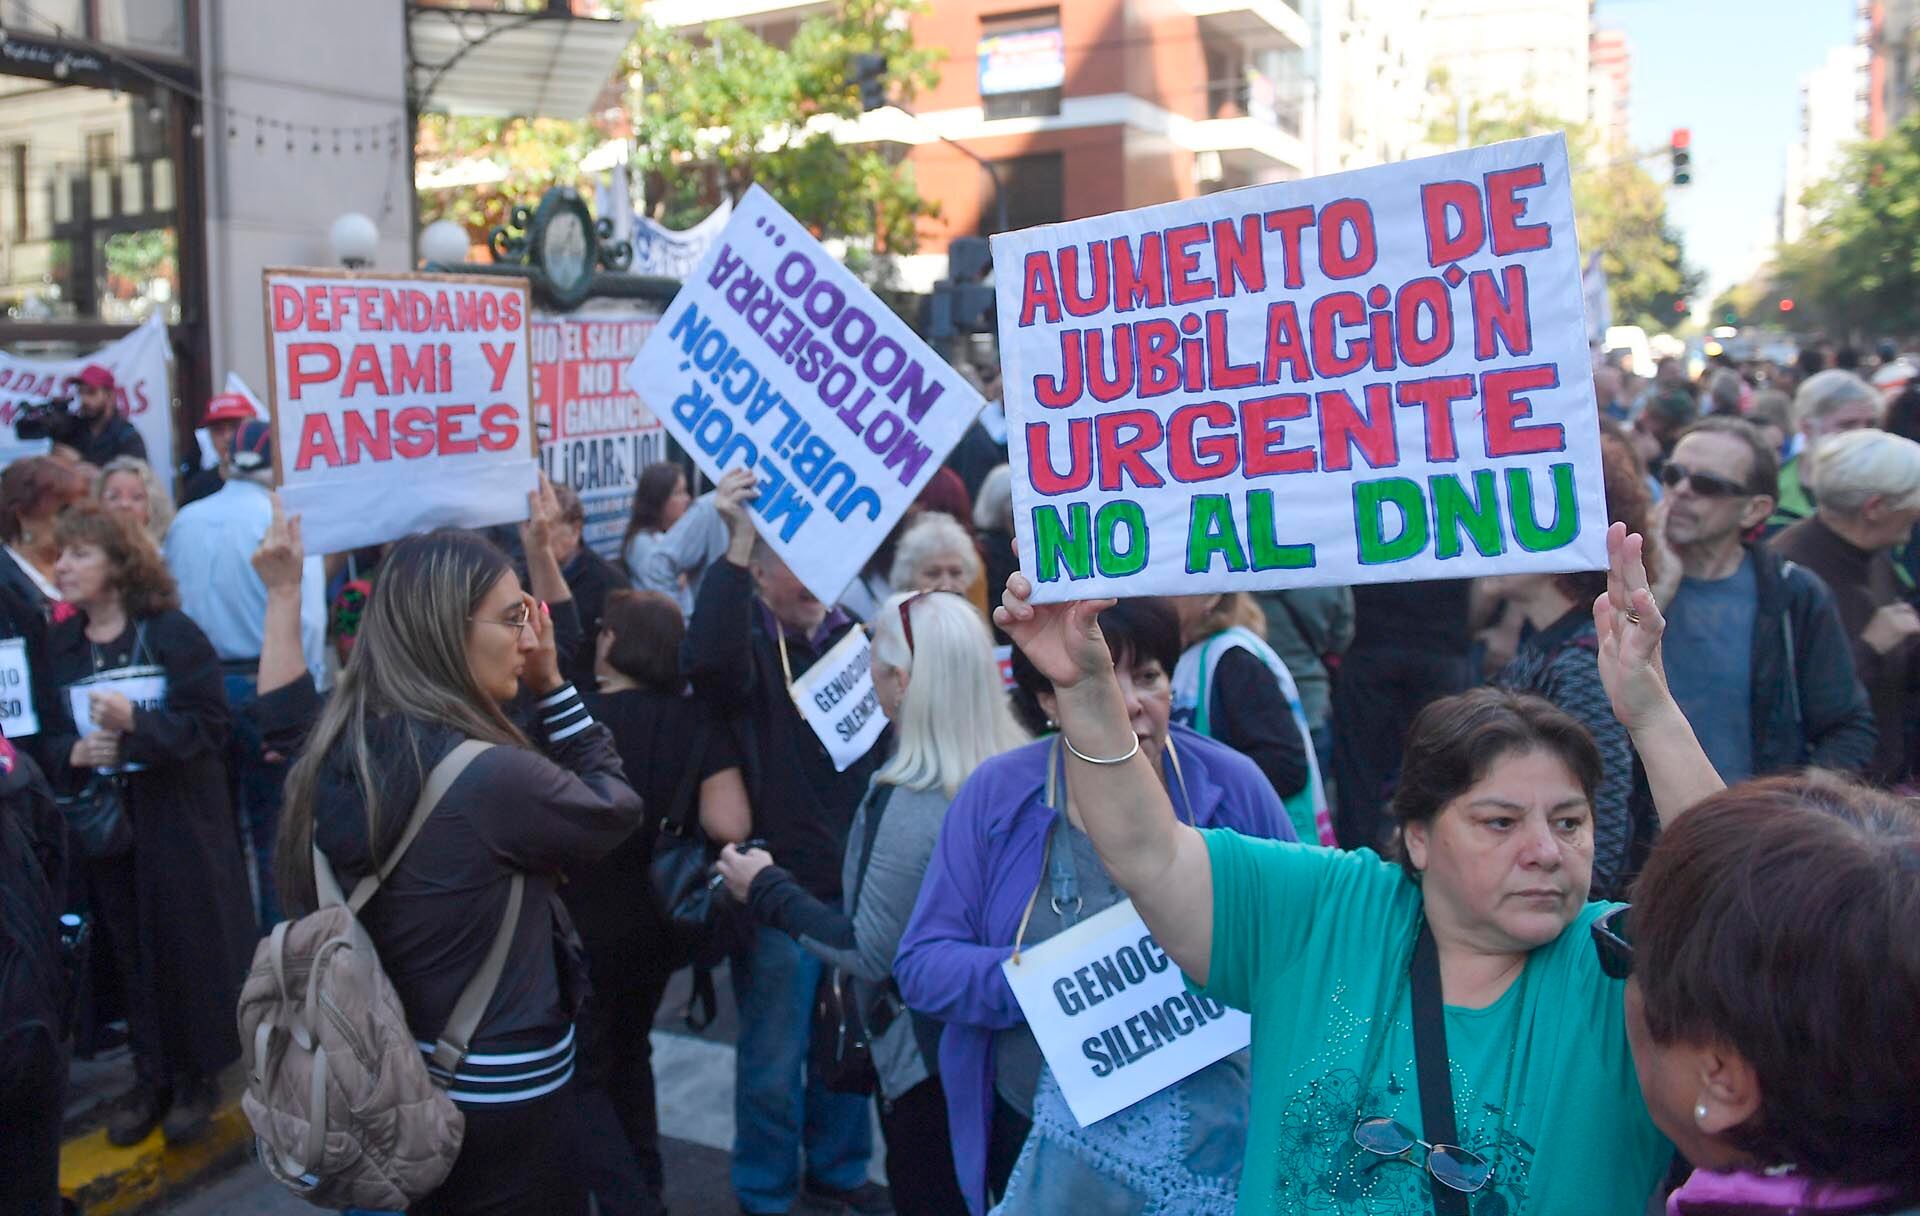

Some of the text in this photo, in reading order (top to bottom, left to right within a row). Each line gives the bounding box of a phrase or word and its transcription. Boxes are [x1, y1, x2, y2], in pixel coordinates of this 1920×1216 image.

[1018, 163, 1552, 327] AUMENTO DE
[272, 284, 522, 333] DEFENDAMOS
[562, 323, 583, 361] EL
[480, 342, 516, 392] Y
[578, 362, 613, 395] NO
[294, 403, 520, 471] ANSES
[671, 380, 815, 544] MEJOR
[1025, 363, 1567, 496] URGENTE
[1031, 463, 1582, 583] NO AL DNU
[1053, 935, 1169, 1017] GENOC
[1081, 989, 1226, 1078] SILENCIO
